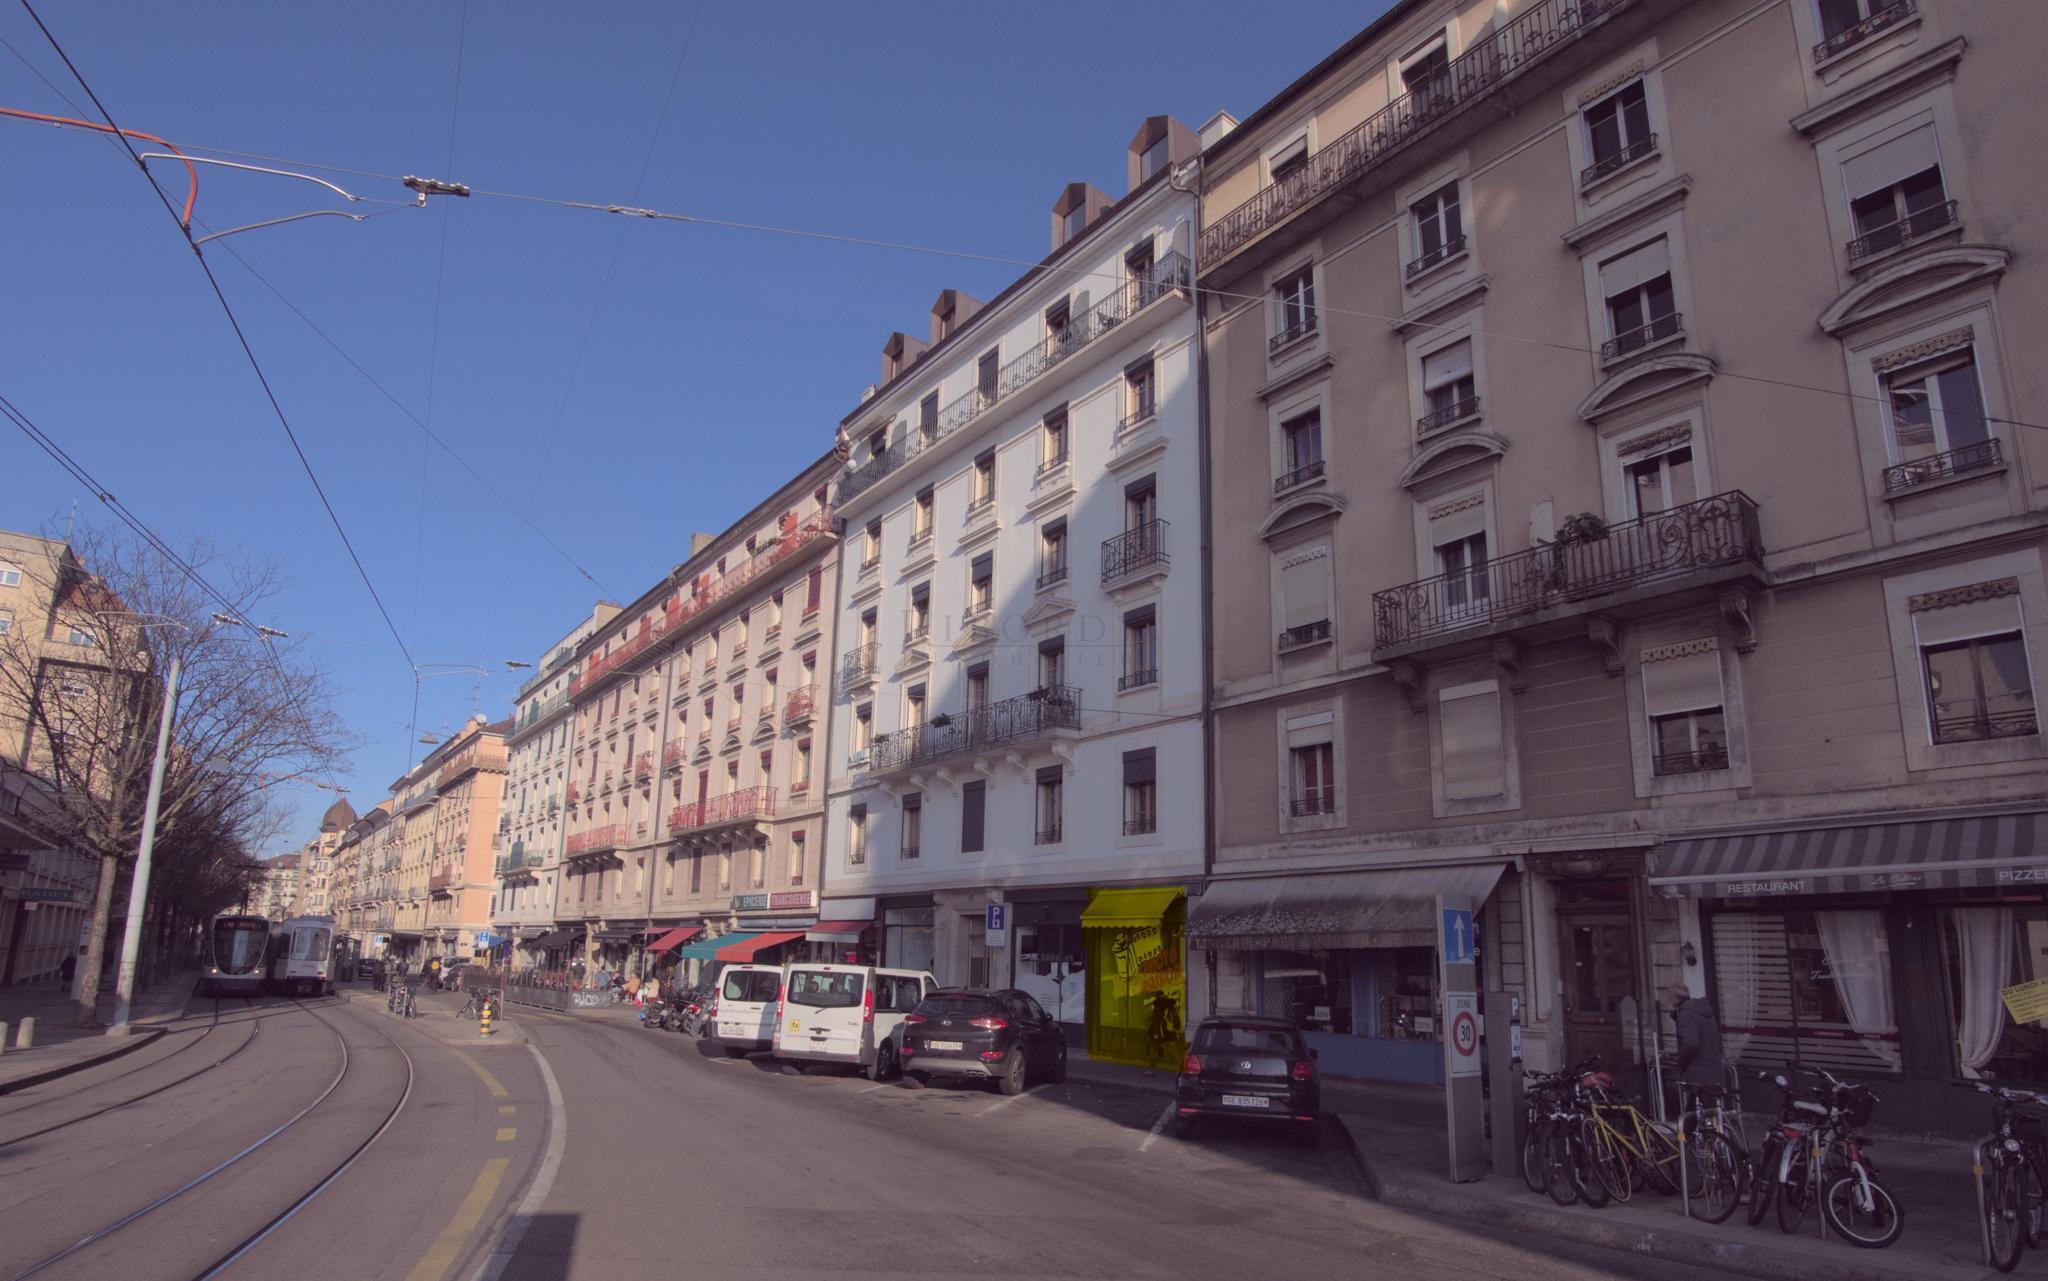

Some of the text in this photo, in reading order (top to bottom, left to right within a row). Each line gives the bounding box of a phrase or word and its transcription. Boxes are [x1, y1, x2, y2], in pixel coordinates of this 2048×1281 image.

[1727, 879, 1807, 894] RESTAURANT
[743, 895, 767, 907] EPICERIE
[992, 906, 1001, 919] P
[2001, 988, 2014, 997] DU
[2015, 982, 2039, 993] LUNDI
[1456, 999, 1472, 1009] ZONE
[1511, 997, 1519, 1017] P
[1459, 1025, 1471, 1042] 30
